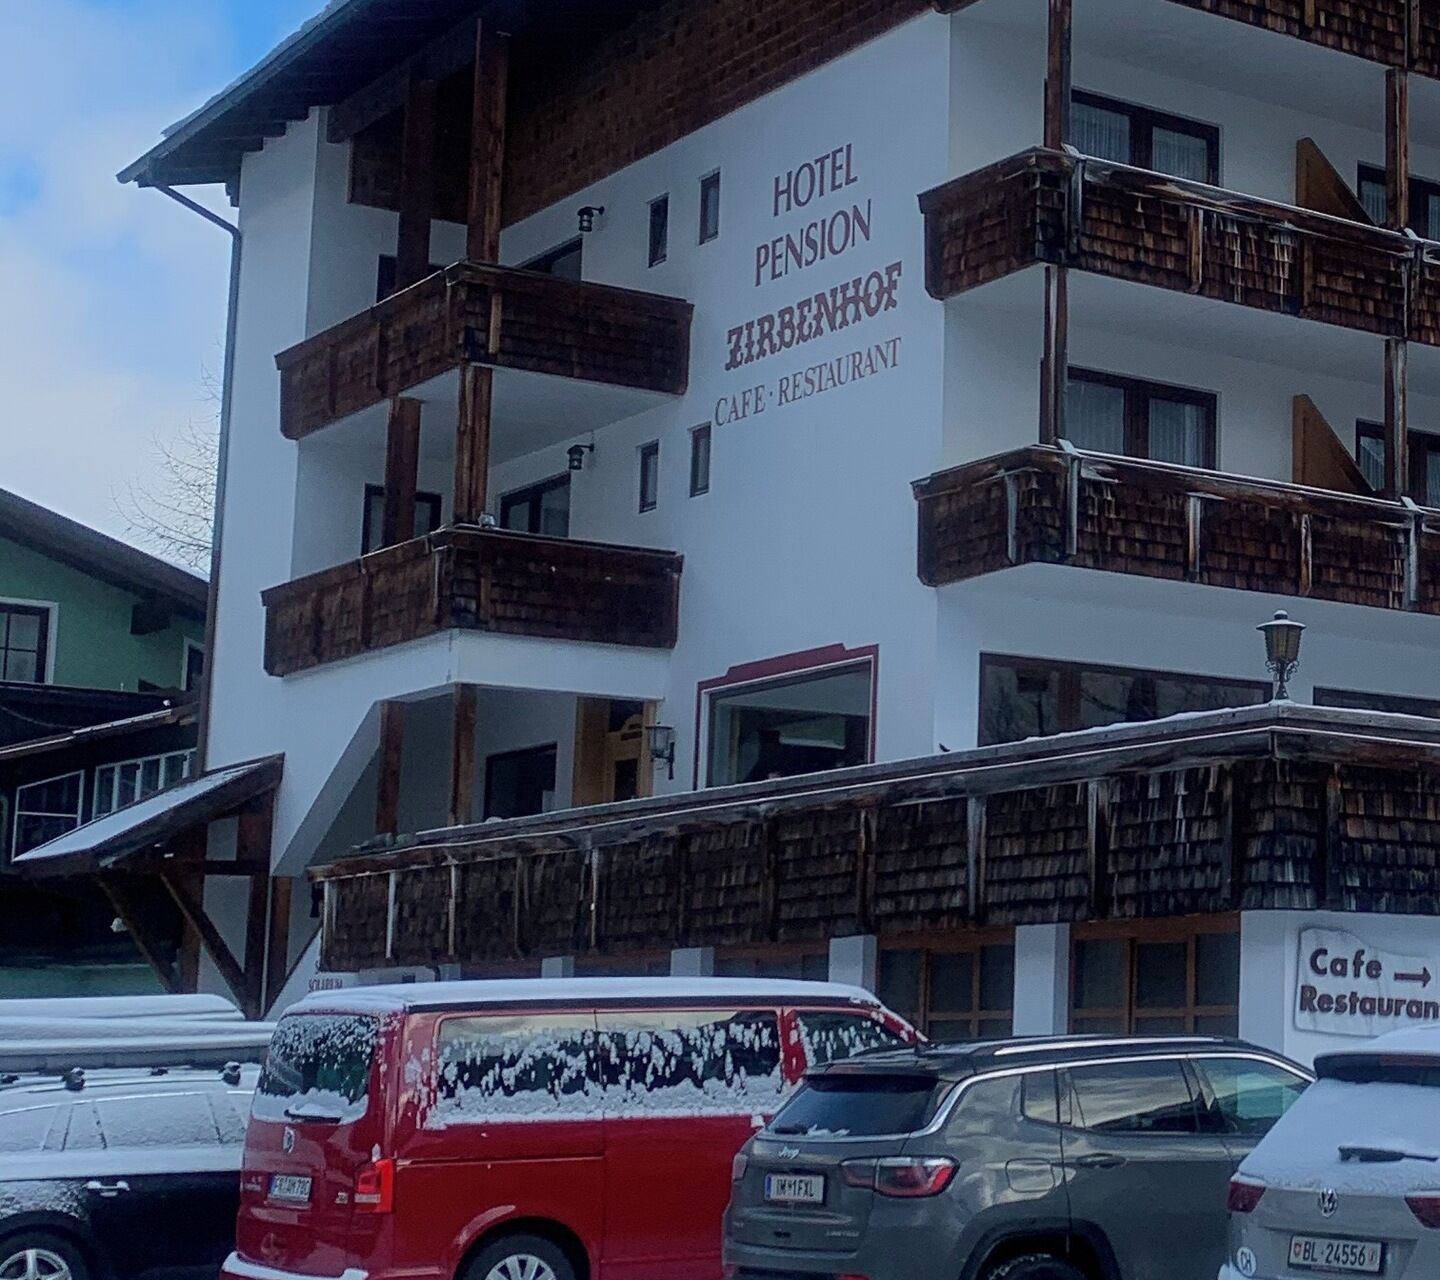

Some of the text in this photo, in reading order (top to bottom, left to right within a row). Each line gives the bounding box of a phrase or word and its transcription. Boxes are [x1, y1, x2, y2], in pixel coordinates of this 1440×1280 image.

[772, 143, 858, 218] HOTEL
[754, 198, 873, 287] PENSION
[724, 260, 903, 372] ZIRBENHOF
[714, 337, 903, 427] CAFE RESTAURANT
[1309, 947, 1383, 980] Cafe
[1302, 1239, 1367, 1266] BL 24556
